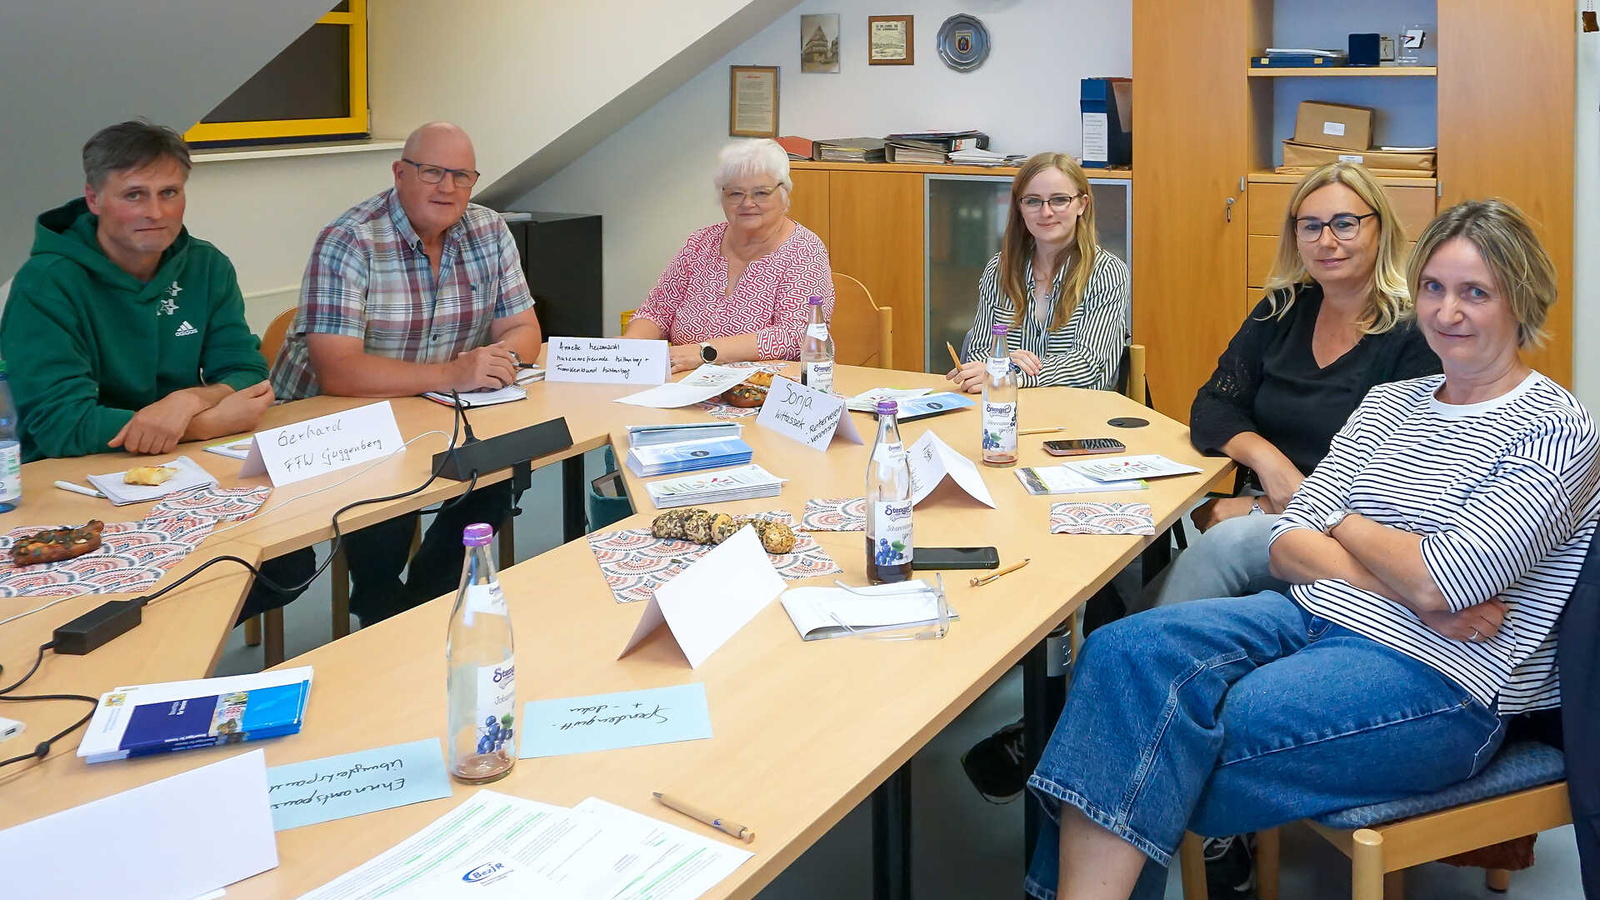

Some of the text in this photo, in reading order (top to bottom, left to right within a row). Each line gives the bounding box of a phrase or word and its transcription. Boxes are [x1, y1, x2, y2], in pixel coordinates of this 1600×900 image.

[175, 328, 198, 337] adidas
[780, 383, 813, 416] Sonja
[277, 418, 343, 447] Gerhard
[284, 437, 382, 473] FFW Guggenberg
